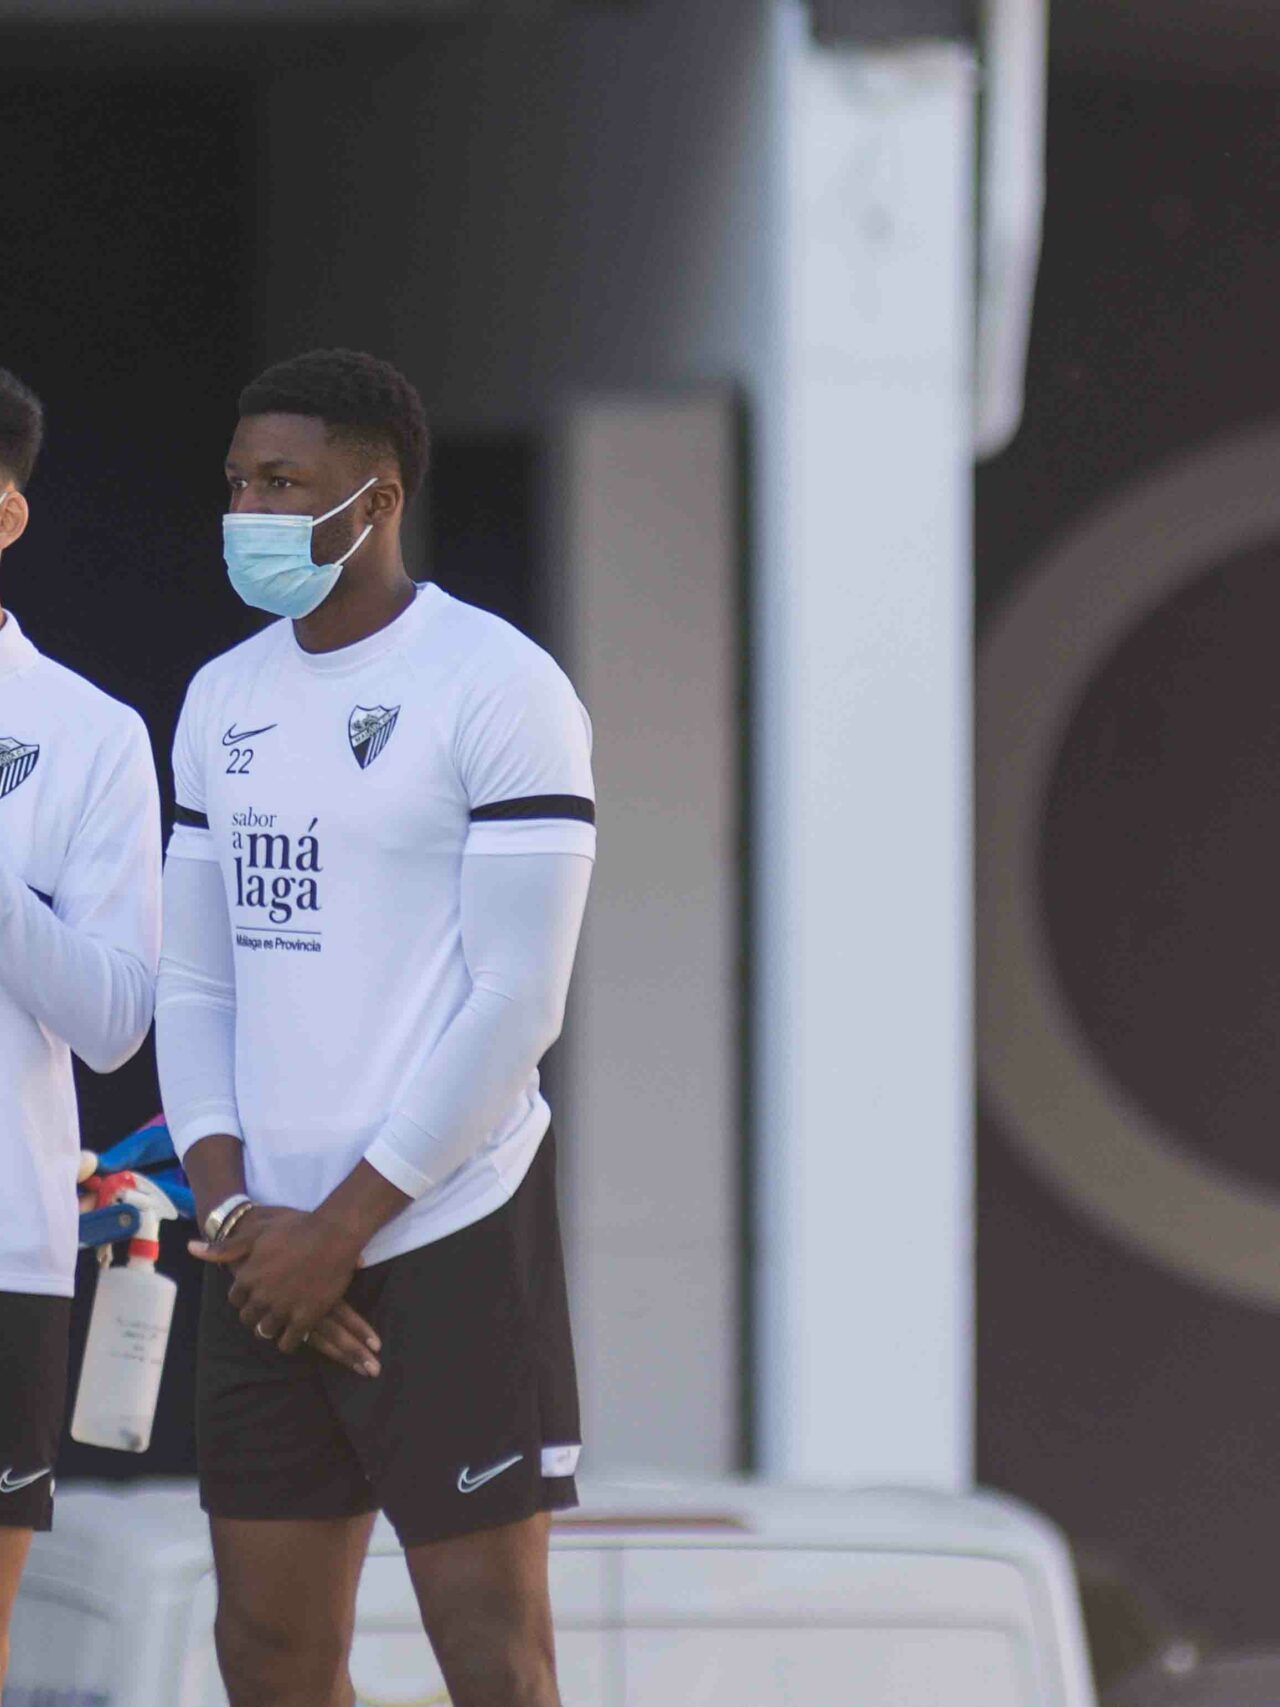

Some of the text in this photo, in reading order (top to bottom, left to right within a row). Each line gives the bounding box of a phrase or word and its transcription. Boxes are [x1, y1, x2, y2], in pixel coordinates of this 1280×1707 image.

[225, 748, 255, 774] 22
[231, 806, 277, 828] sabor
[232, 817, 323, 873] a má
[234, 856, 322, 925] laga
[263, 938, 274, 951] es
[275, 936, 322, 954] Provincia
